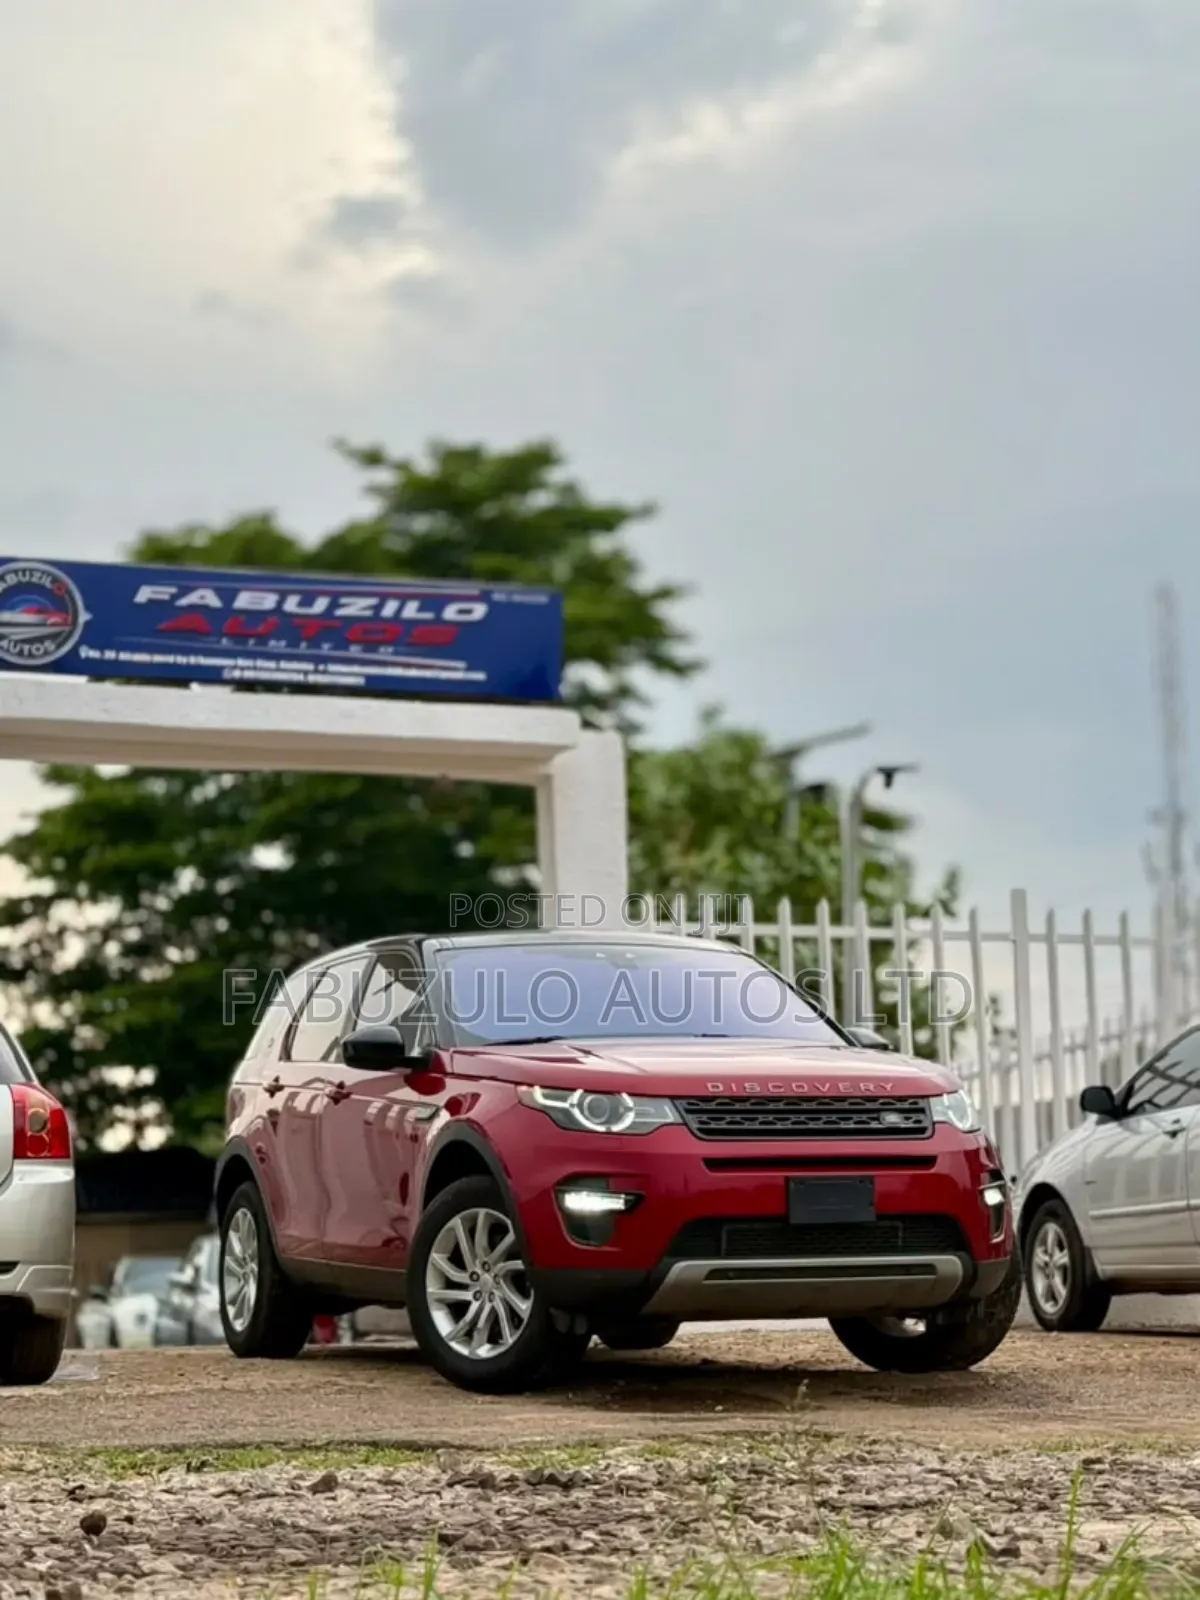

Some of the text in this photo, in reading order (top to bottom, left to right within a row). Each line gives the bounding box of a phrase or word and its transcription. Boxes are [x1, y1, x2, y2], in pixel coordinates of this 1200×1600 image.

[133, 585, 488, 622] FABUZILO
[157, 614, 459, 645] AUTOS
[706, 1082, 895, 1093] DISCOVERY
